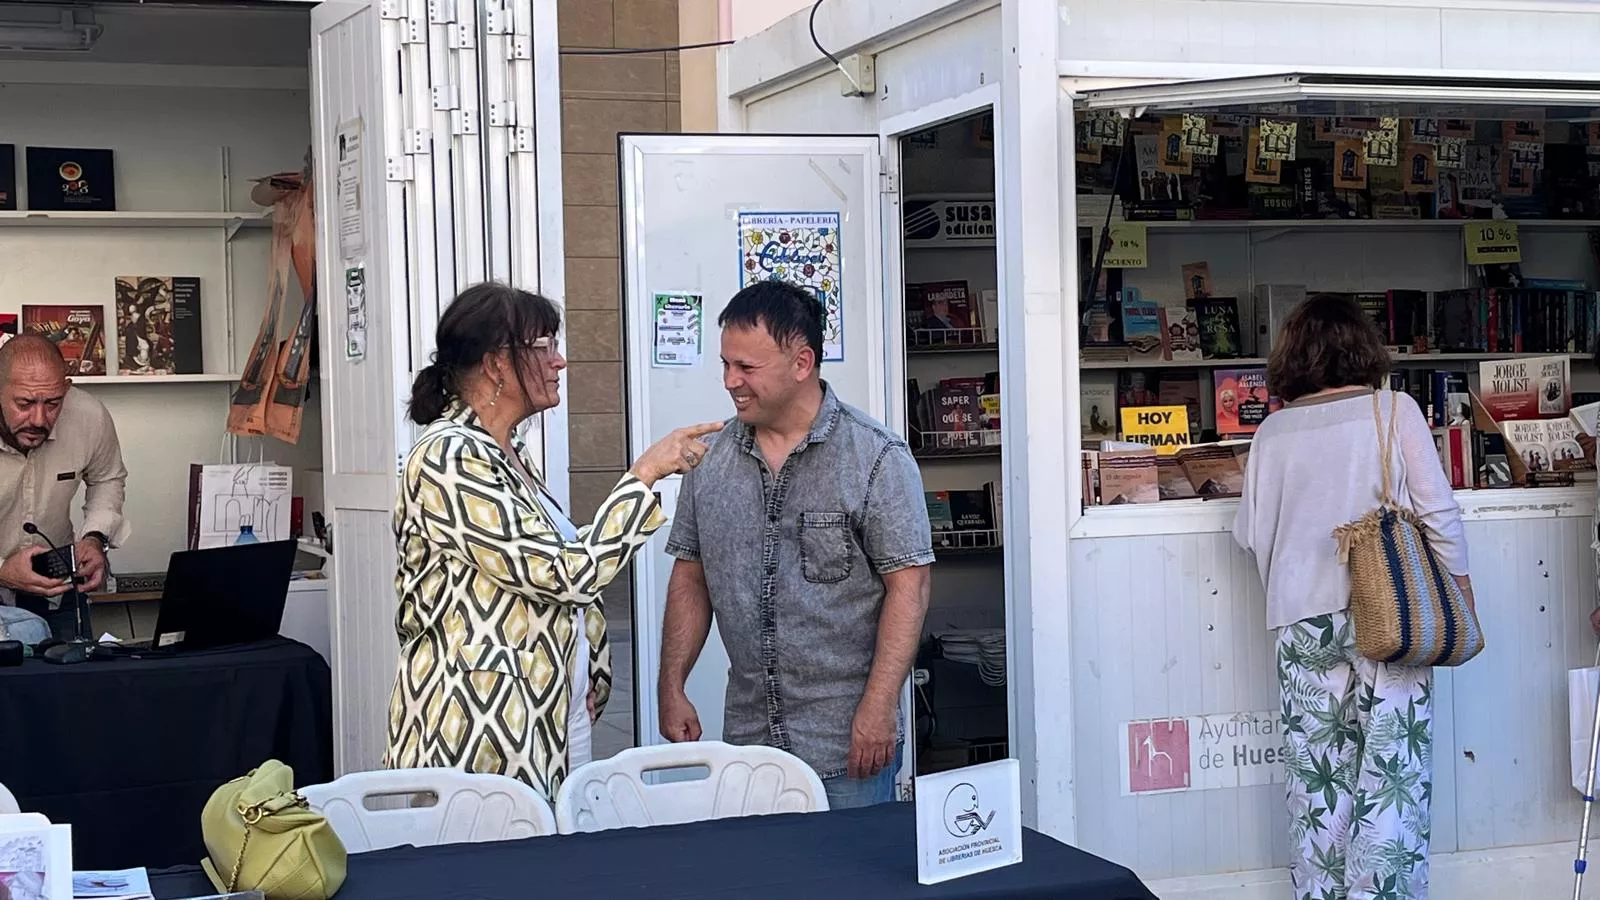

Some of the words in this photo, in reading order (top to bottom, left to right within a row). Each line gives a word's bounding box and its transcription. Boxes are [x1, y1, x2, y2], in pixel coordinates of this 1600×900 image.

[1304, 166, 1313, 203] TRENES
[946, 205, 995, 222] susa
[946, 223, 995, 235] edicion
[1479, 228, 1495, 241] 10
[1498, 228, 1511, 241] %
[1120, 240, 1128, 248] 10
[1131, 240, 1139, 248] %
[1204, 305, 1234, 315] LUNA
[67, 314, 91, 324] Goya
[1493, 363, 1527, 379] JORGE
[1492, 378, 1530, 394] MOLIST
[942, 414, 960, 424] QUE
[962, 413, 972, 423] SE
[1138, 411, 1173, 425] HOY
[1514, 423, 1540, 433] JORGE
[1126, 432, 1187, 446] FIRMAN
[1514, 433, 1544, 443] MOLIST
[1199, 747, 1224, 770] de
[970, 837, 1000, 848] PROVINCIAL
[938, 857, 946, 865] DE
[974, 848, 981, 857] DE
[982, 844, 1003, 855] HUESCA
